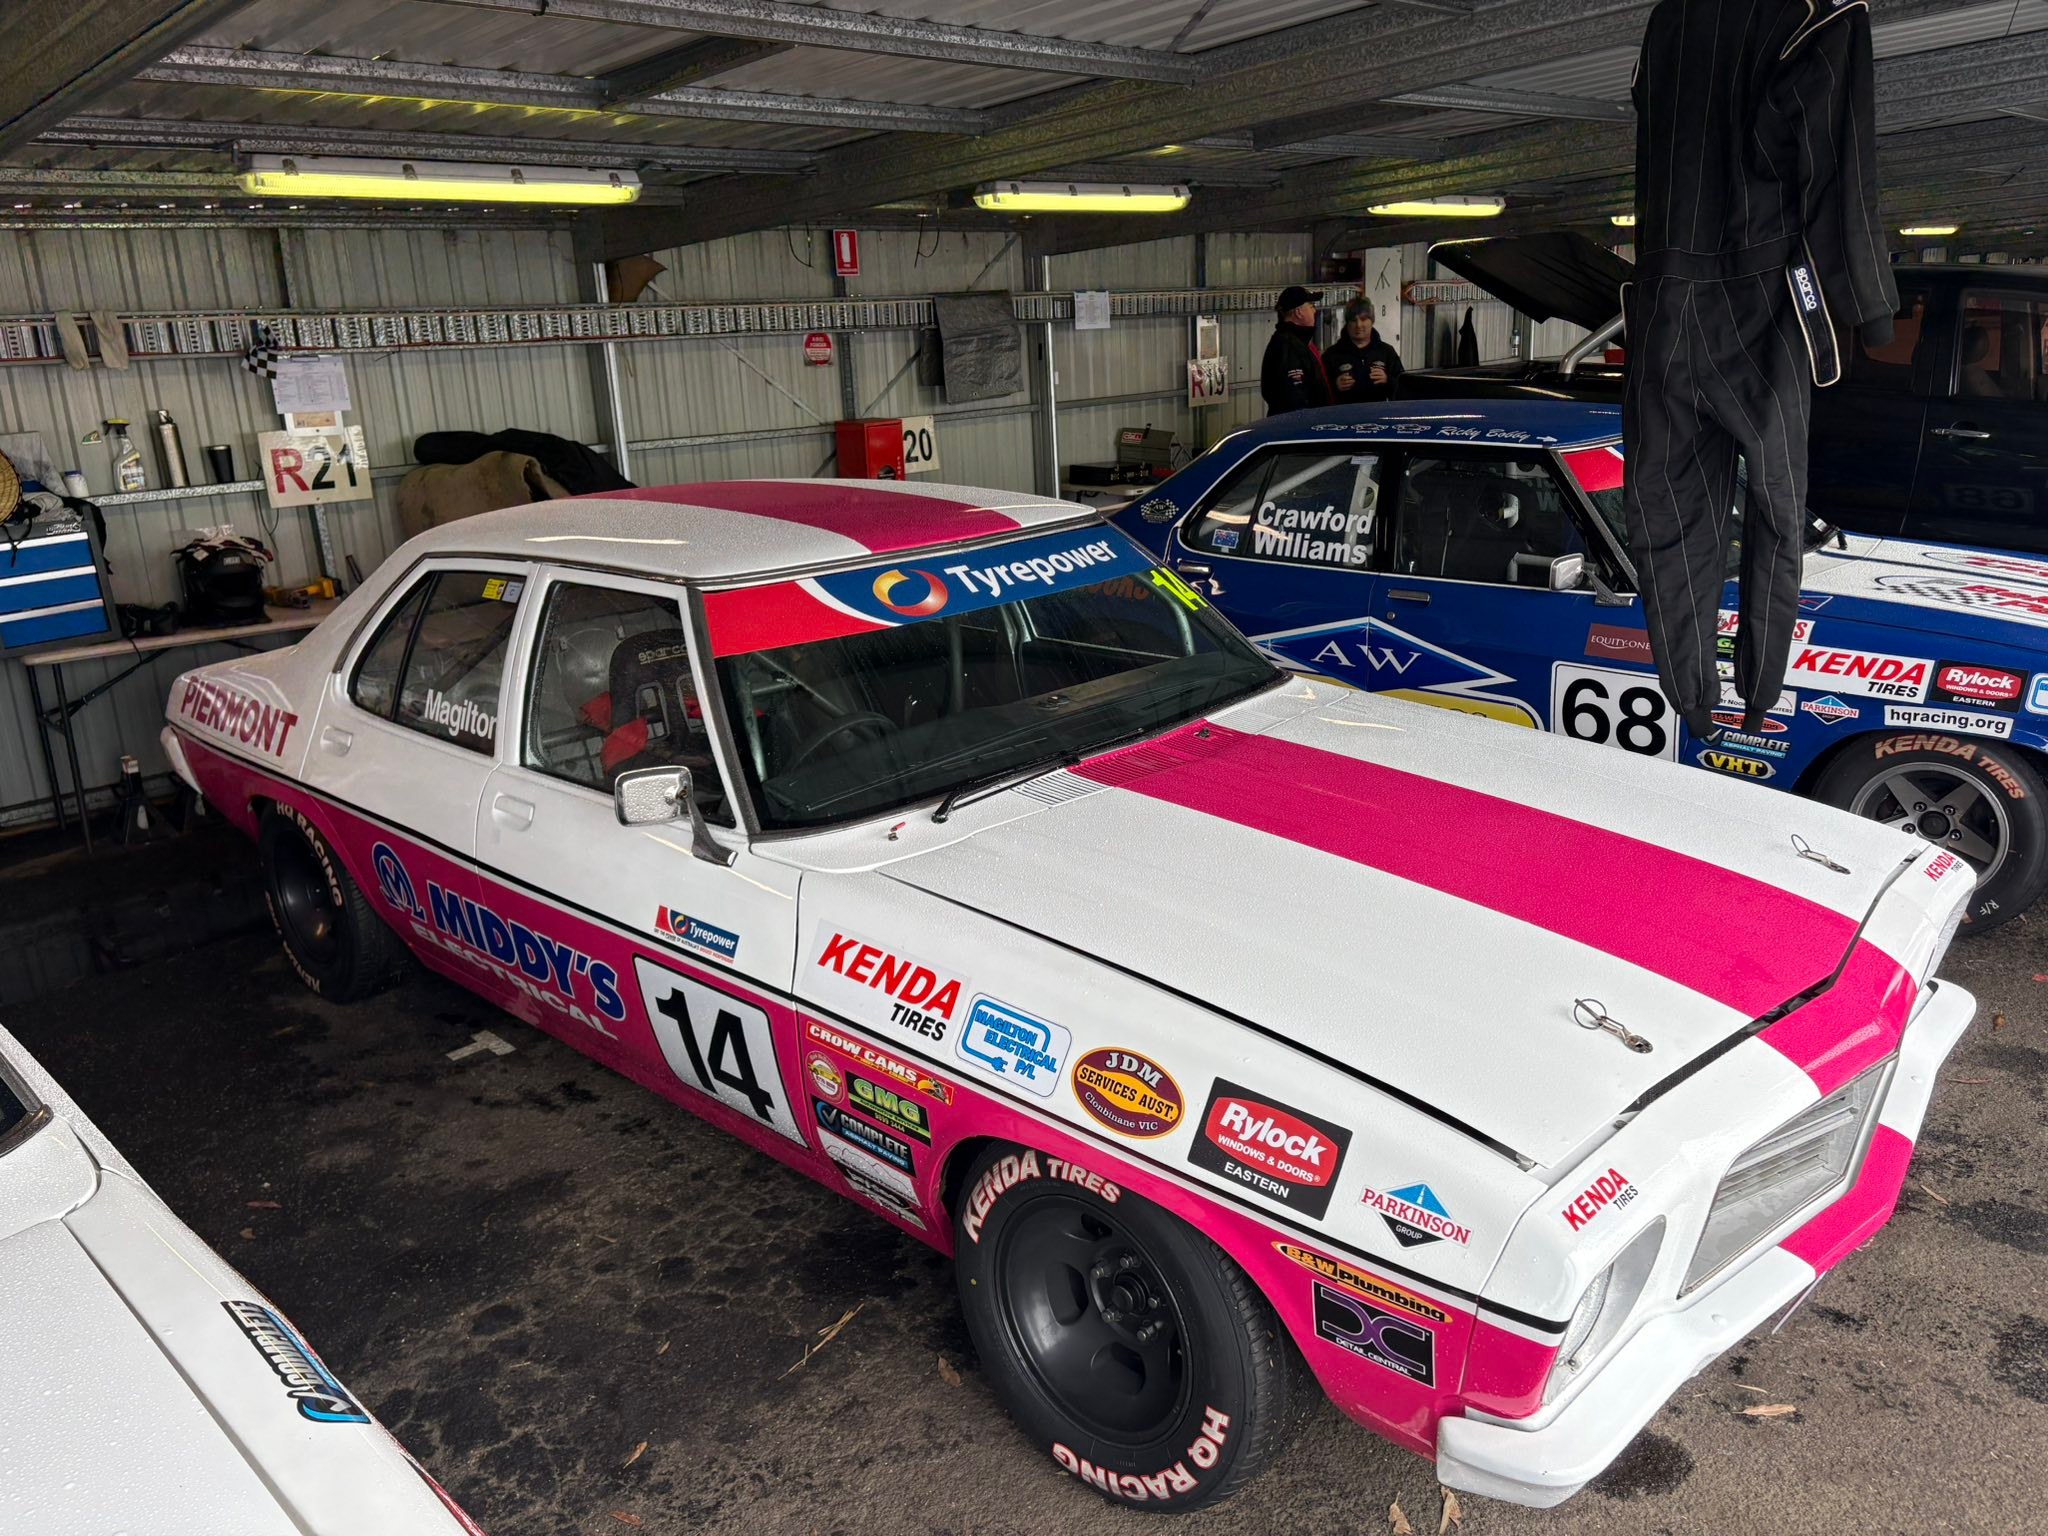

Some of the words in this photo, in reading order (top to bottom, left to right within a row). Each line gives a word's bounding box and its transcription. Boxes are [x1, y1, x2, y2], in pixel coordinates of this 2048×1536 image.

[1795, 267, 1817, 311] sparco
[903, 428, 933, 463] 20
[1436, 425, 1482, 440] Ricky
[1486, 428, 1531, 442] Bobby
[270, 443, 358, 493] R21
[1257, 501, 1376, 535] Crawford
[944, 538, 1119, 598] Tyrepower
[1253, 529, 1368, 565] Williams
[1150, 566, 1208, 611] 14
[1791, 648, 1928, 686] KENDA
[1945, 668, 2015, 690] Rylock
[1802, 701, 1858, 718] PARKINSON
[1866, 681, 1920, 698] TIRES
[1945, 684, 1978, 694] WINDOWS
[1953, 695, 1996, 707] EASTERN
[180, 675, 299, 757] PIERMONT
[1562, 678, 1667, 757] 68
[1889, 709, 2007, 734] hqracing.org
[1722, 730, 1791, 753] COMPLETE
[1709, 752, 1763, 775] VHT
[1874, 734, 1979, 761] KENDA
[1976, 755, 2026, 800] TIRES
[276, 800, 294, 821] HQ
[296, 811, 343, 907] RACING
[1923, 850, 1958, 883] KENDA
[426, 879, 627, 1022] MIDDY'S
[689, 921, 736, 951] Tyrepower
[409, 920, 620, 1041] ELECTRICAL
[817, 932, 962, 1021] KENDA
[889, 1002, 947, 1042] TIRES
[974, 1008, 1038, 1045] MAGILTON
[655, 986, 776, 1125] 14
[809, 1024, 862, 1055] CROW
[864, 1049, 918, 1082] CAMS
[983, 1029, 1058, 1073] ELECTRICAL
[1013, 1060, 1036, 1081] P/L
[1105, 1051, 1164, 1089] JDM
[853, 1078, 921, 1125] GMG
[1079, 1066, 1138, 1104] SERVICES
[1138, 1093, 1175, 1121] AUST.
[1084, 1091, 1136, 1128] Clonbinane
[1138, 1121, 1159, 1131] VIC
[840, 1113, 909, 1159] COMPLETE
[1217, 1133, 1267, 1163] WINDOWS
[1266, 1155, 1276, 1167] &
[1219, 1101, 1328, 1167] Rylock
[962, 1149, 1041, 1244] KENDA
[1046, 1157, 1122, 1203] TIRES
[1223, 1160, 1290, 1199] EASTERN
[1561, 1167, 1630, 1233] KENDA
[1612, 1184, 1639, 1211] TIRES
[1361, 1187, 1472, 1245] PARKINSON
[1394, 1224, 1424, 1240] GROUP
[1286, 1246, 1337, 1276] B&W
[1338, 1268, 1446, 1323] Plumbing
[228, 1300, 325, 1387] COMPLETE
[1335, 1336, 1368, 1357] DETAIL
[1367, 1350, 1412, 1377] CENTRAL
[1187, 1404, 1231, 1470] HQ
[1052, 1441, 1200, 1501] RACING
